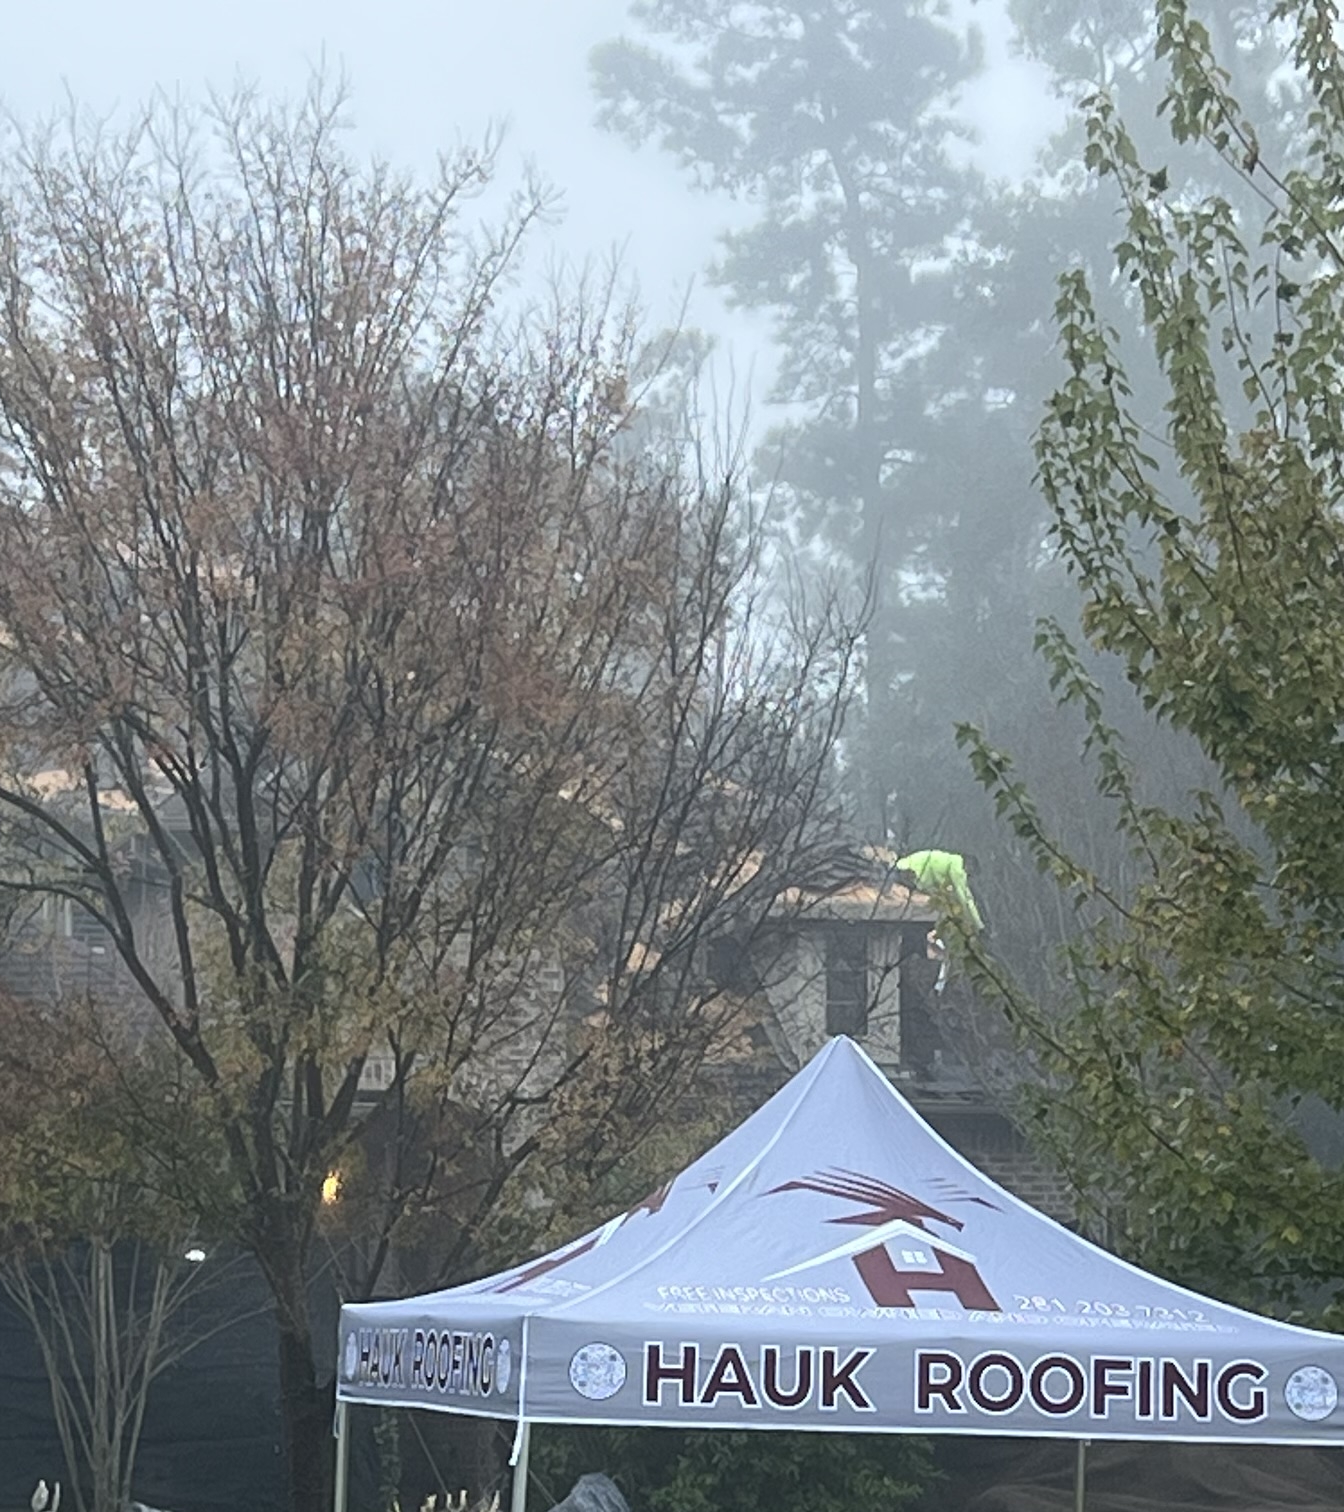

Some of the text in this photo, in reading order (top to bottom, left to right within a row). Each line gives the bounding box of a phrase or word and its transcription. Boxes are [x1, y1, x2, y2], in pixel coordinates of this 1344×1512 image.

[657, 1286, 851, 1304] FREE INSPECTIONS
[360, 1328, 495, 1397] HAUK ROOFING
[643, 1342, 1269, 1423] HAUK ROOFING
